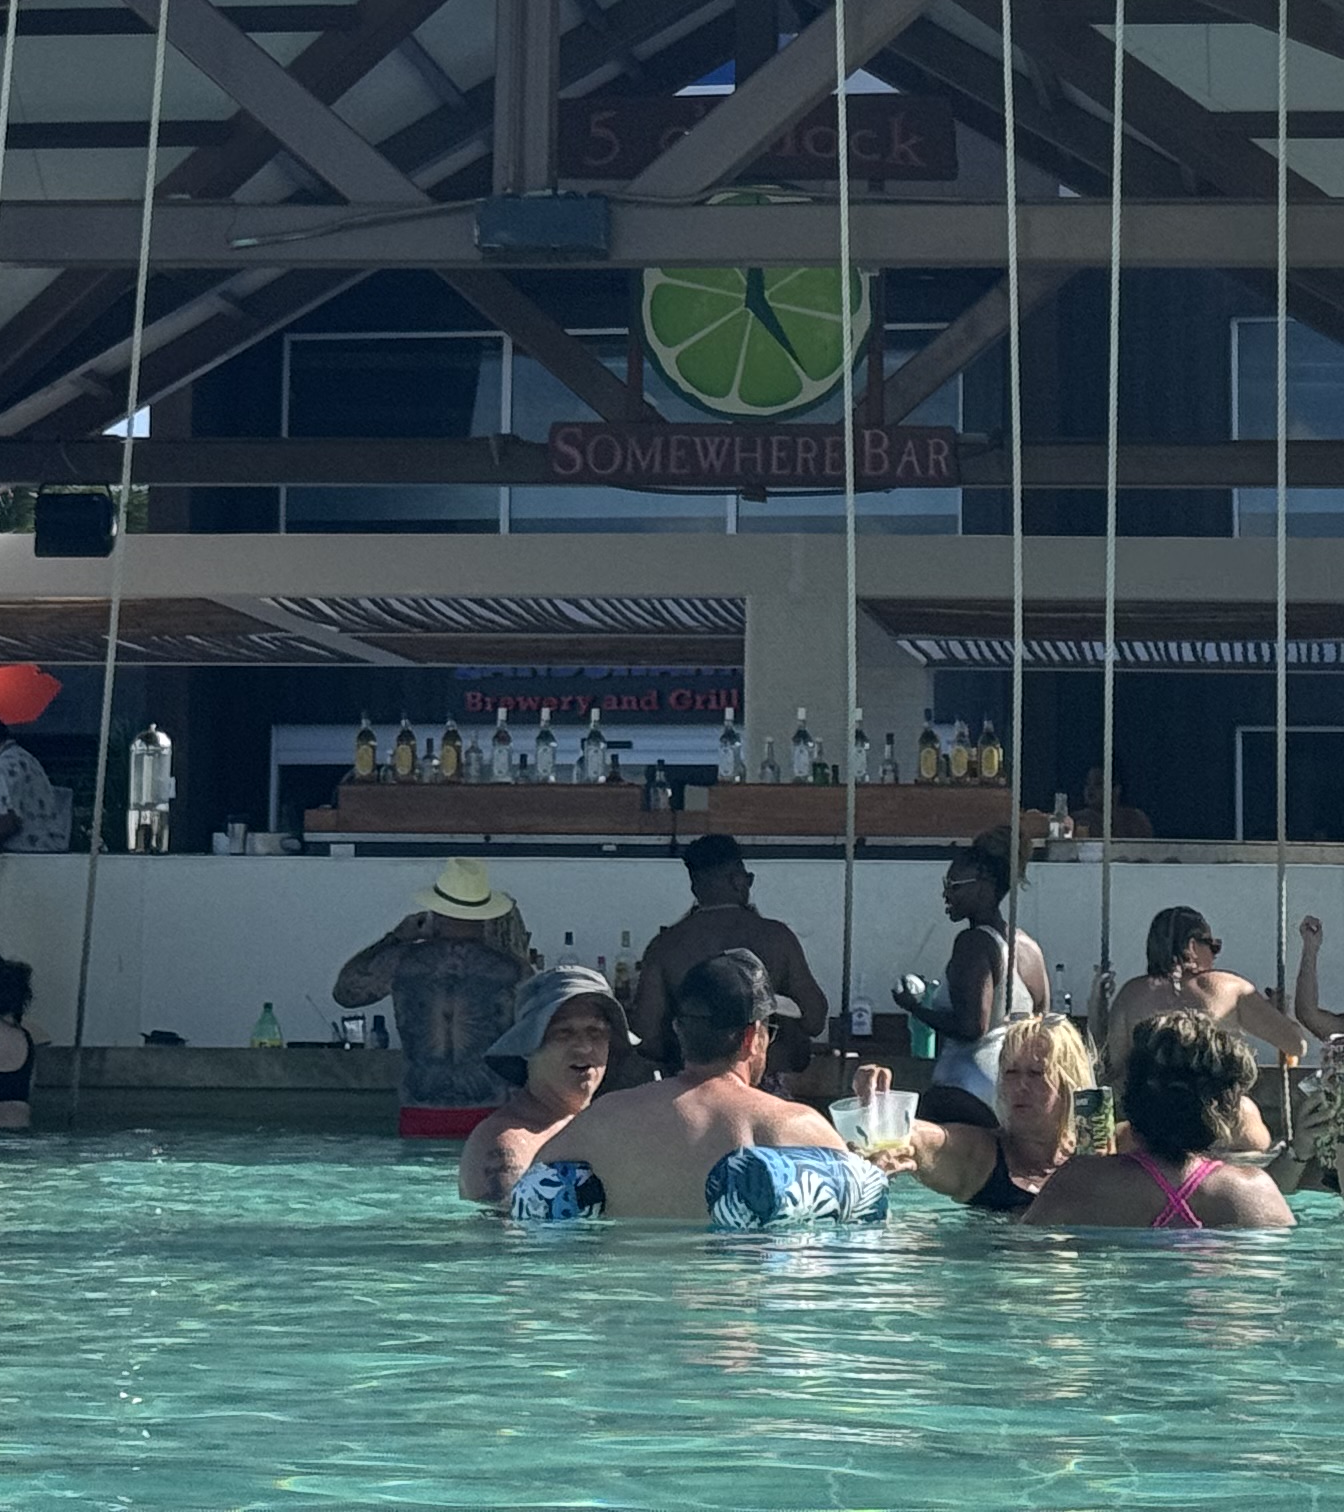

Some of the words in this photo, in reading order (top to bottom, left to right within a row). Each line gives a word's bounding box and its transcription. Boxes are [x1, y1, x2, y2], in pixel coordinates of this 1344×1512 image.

[582, 110, 621, 166] 5
[861, 428, 951, 478] BAR
[464, 690, 594, 717] Brewery
[603, 689, 659, 711] and
[668, 687, 740, 711] Grill
